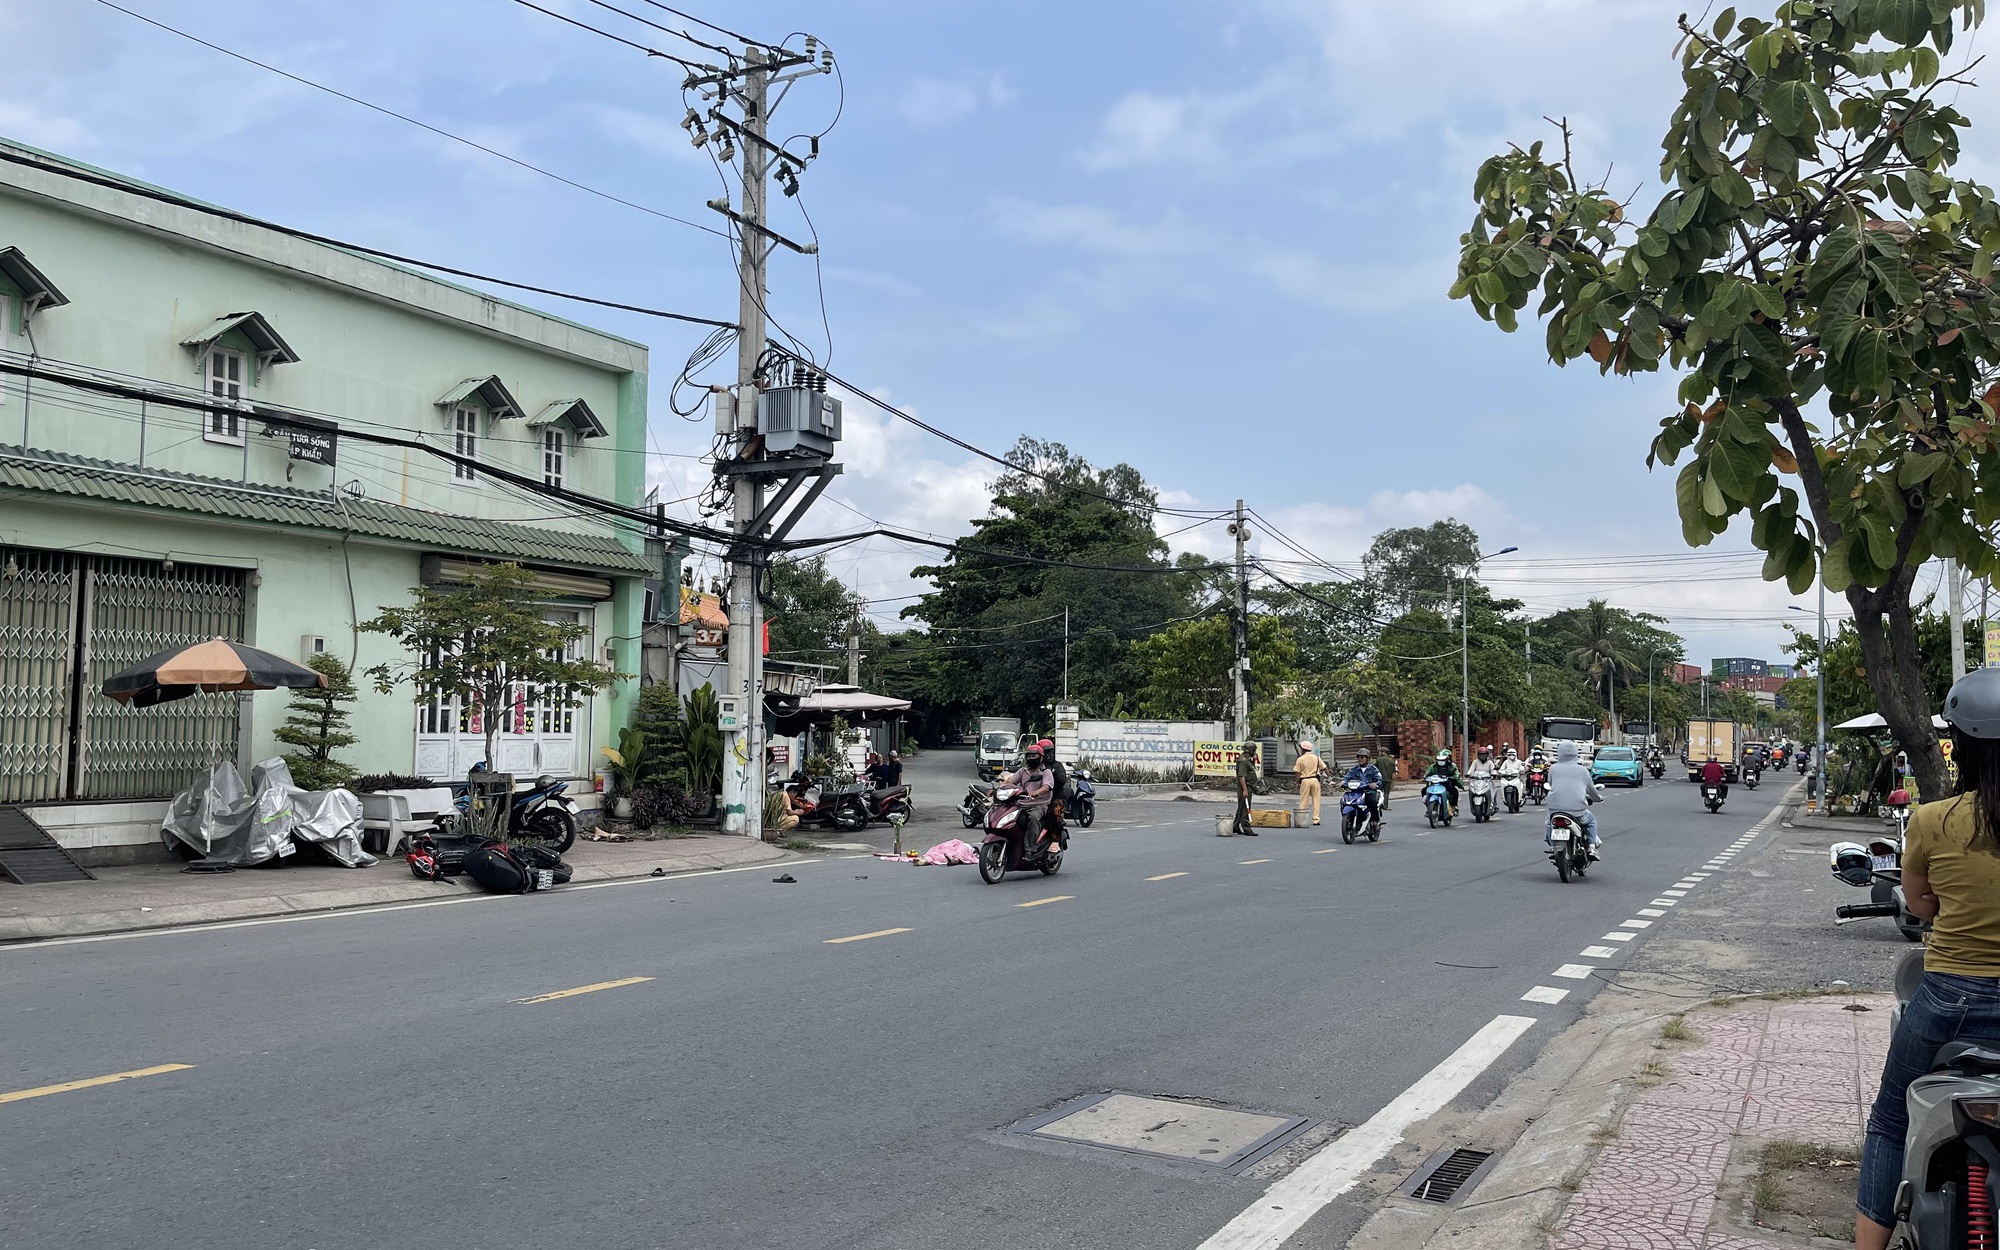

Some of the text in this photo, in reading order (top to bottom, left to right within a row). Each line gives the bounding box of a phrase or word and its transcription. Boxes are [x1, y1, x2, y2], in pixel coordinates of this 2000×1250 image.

[291, 433, 309, 444] TƯƠI
[310, 435, 331, 449] SỐNG
[301, 447, 322, 460] KHẨU
[696, 630, 722, 643] 37
[1222, 743, 1234, 751] CÔ
[1195, 750, 1222, 763] CƠM
